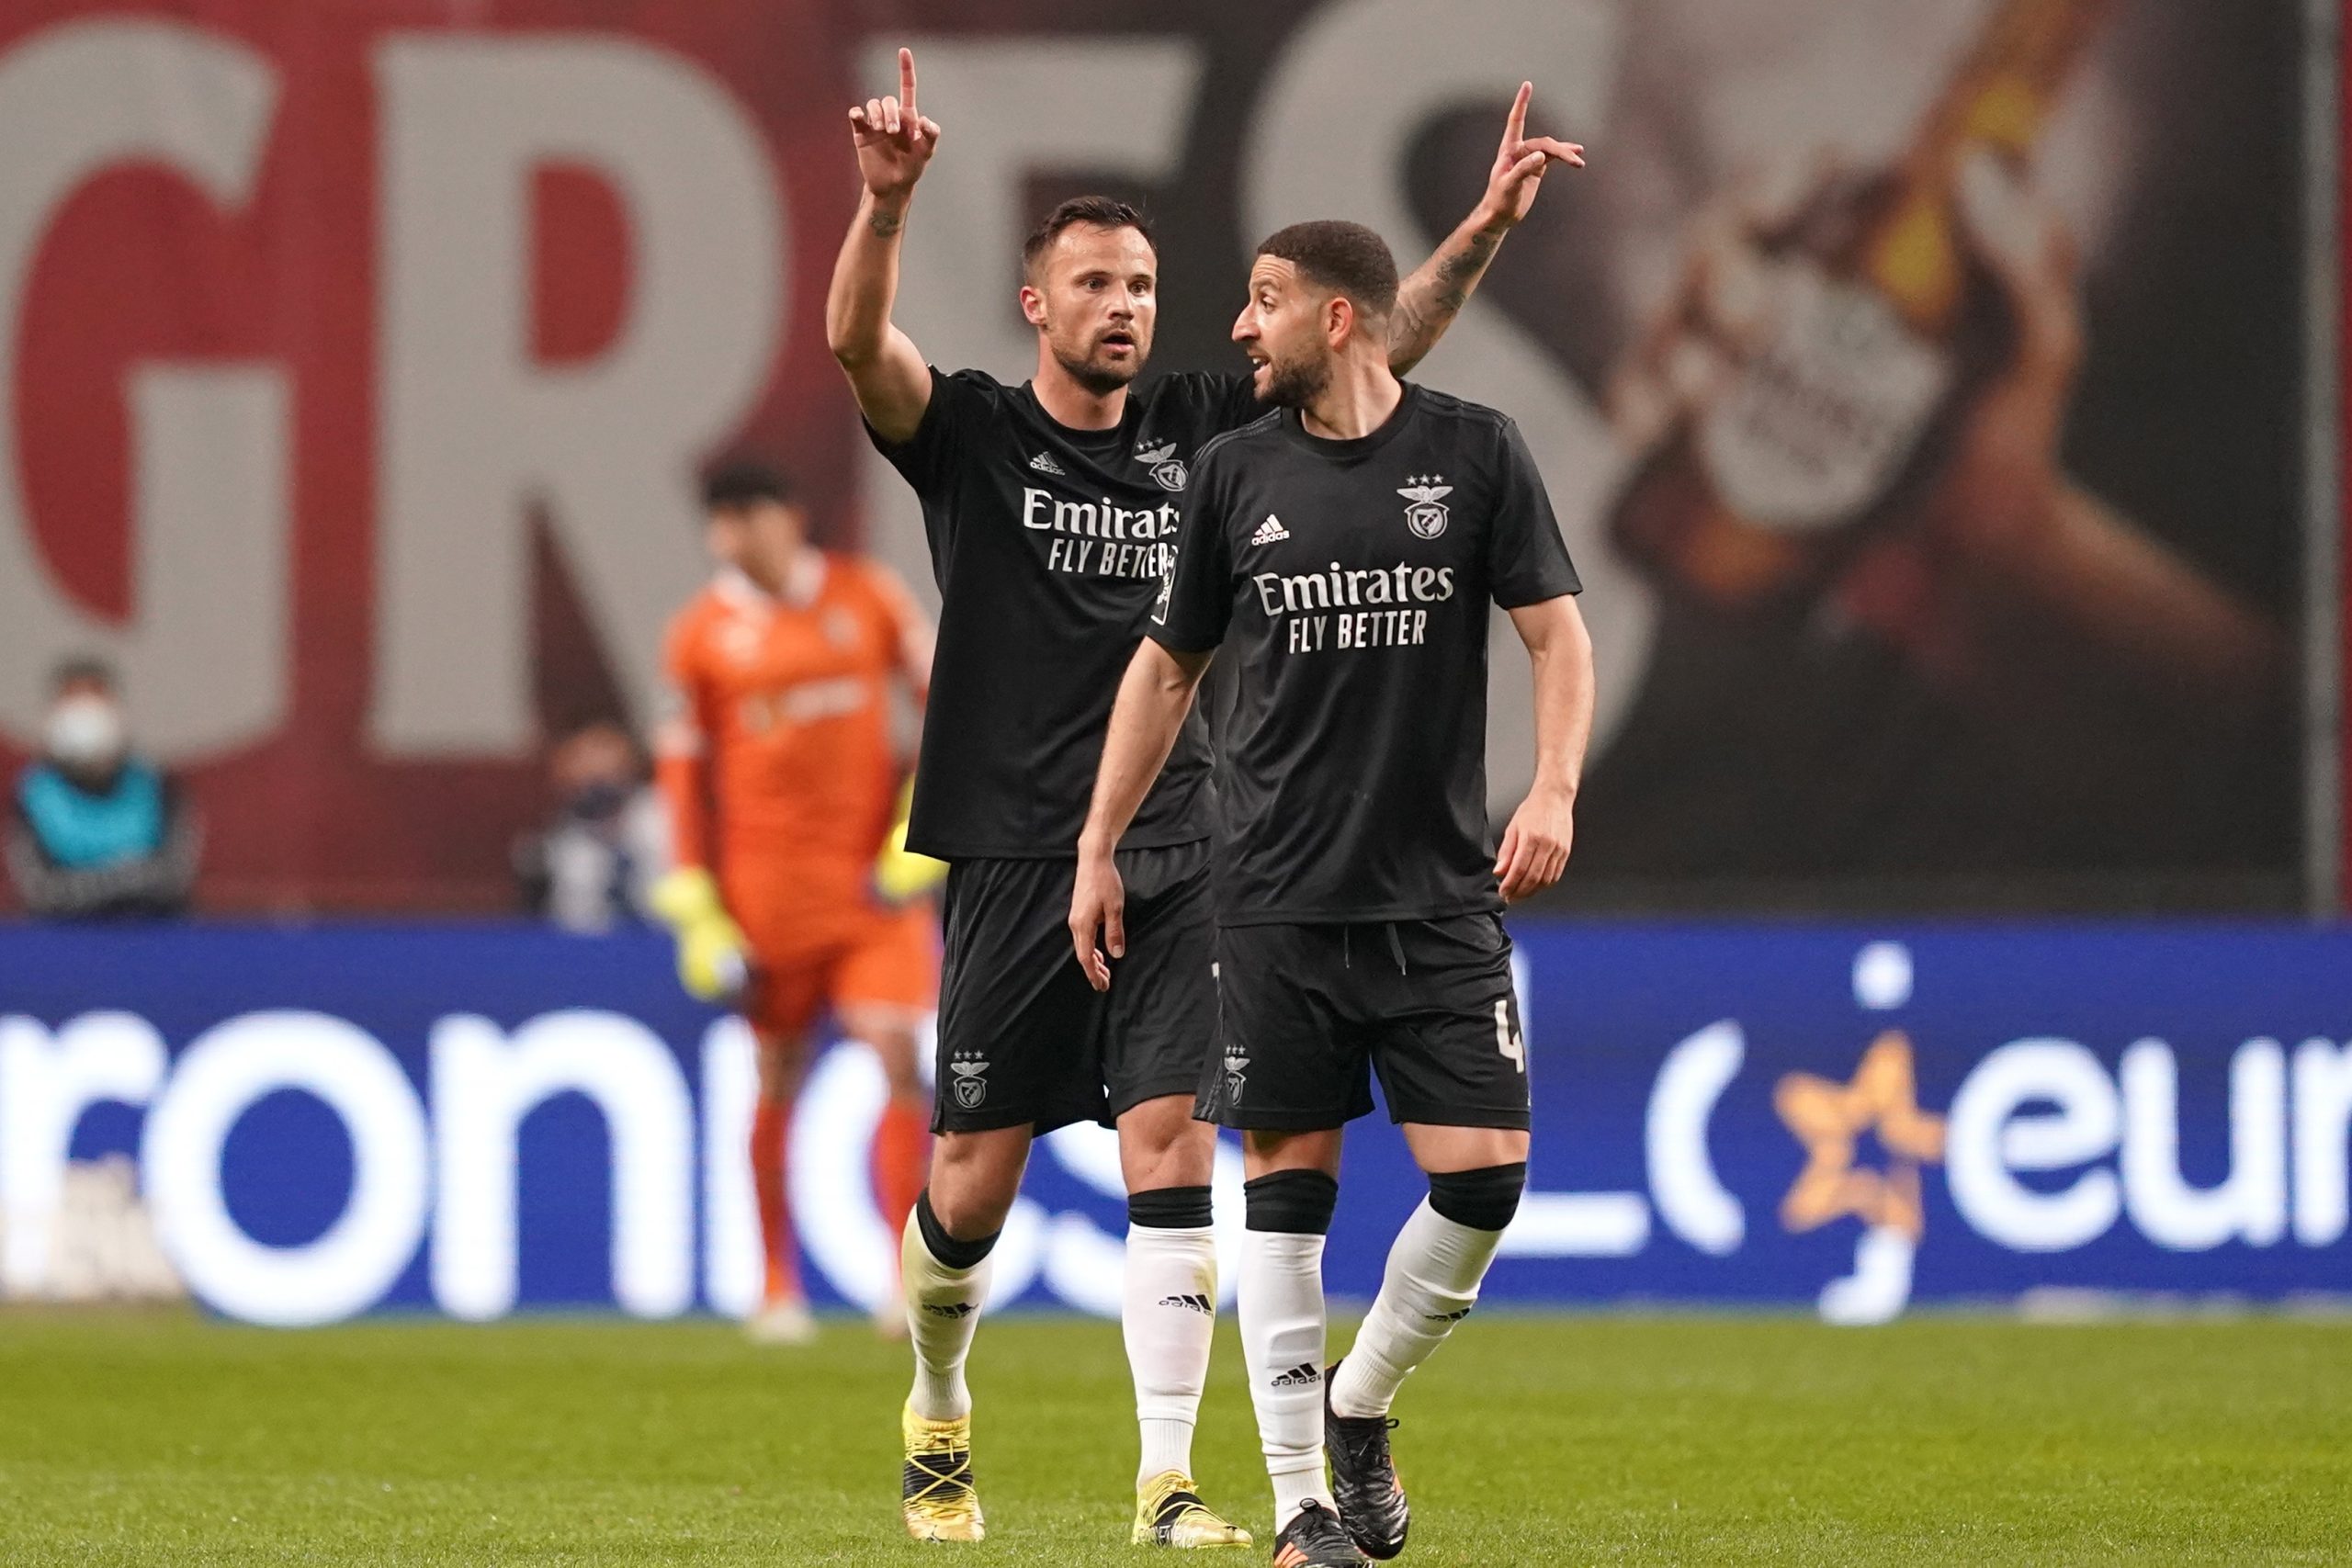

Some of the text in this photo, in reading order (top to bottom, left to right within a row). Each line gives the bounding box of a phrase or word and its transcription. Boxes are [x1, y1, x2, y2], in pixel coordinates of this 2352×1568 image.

[1030, 461, 1066, 476] adidas
[1023, 486, 1180, 540] Emirat
[1251, 530, 1290, 547] adidas
[1047, 538, 1093, 573] FLY
[1253, 560, 1454, 617] Emirates
[1288, 609, 1428, 655] FLY BETTER
[1159, 1300, 1214, 1319] adida
[1271, 1373, 1322, 1386] adidas
